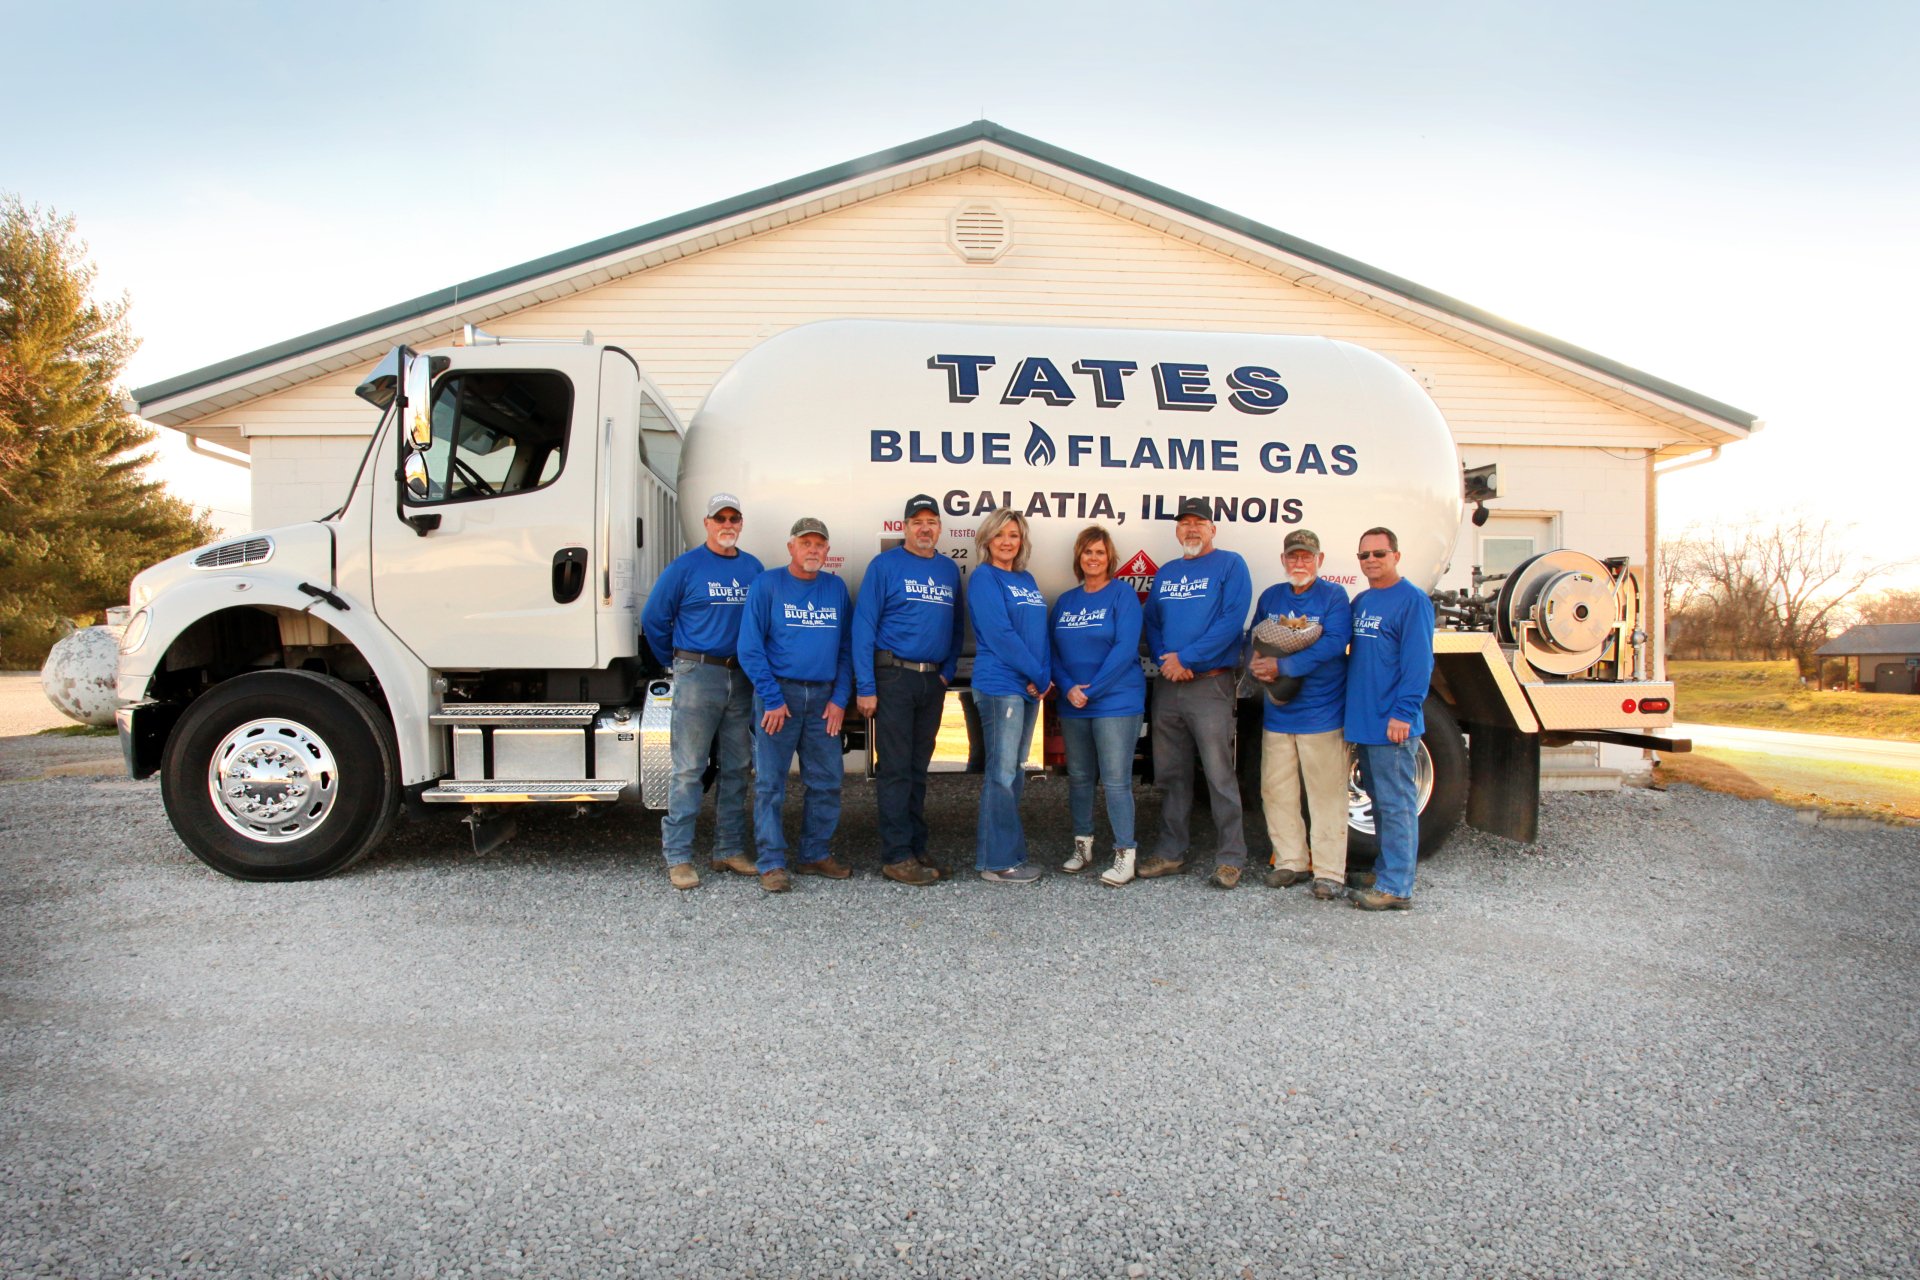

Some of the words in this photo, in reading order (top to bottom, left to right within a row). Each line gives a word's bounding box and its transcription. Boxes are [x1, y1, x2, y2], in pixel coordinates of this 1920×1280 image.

[927, 354, 1289, 415] TATES
[870, 429, 1011, 465] BLUE
[1068, 434, 1239, 472] FLAME
[1259, 441, 1358, 476] GAS
[943, 489, 1126, 525] GALATIA,
[883, 520, 905, 532] NQ
[949, 528, 976, 538] TESTED
[951, 548, 968, 559] 22
[1120, 576, 1156, 592] 075
[1320, 575, 1357, 585] OPANE
[709, 588, 733, 597] BLUE
[905, 585, 928, 594] BLUE
[929, 586, 954, 599] FLAME
[1159, 585, 1179, 593] BLUE
[1179, 582, 1208, 592] FLAME
[784, 610, 808, 619] BLUE
[809, 611, 838, 620] FLAME
[1058, 615, 1078, 623] BLUE
[1077, 612, 1106, 622] FLAME
[1359, 620, 1380, 630] FLAME
